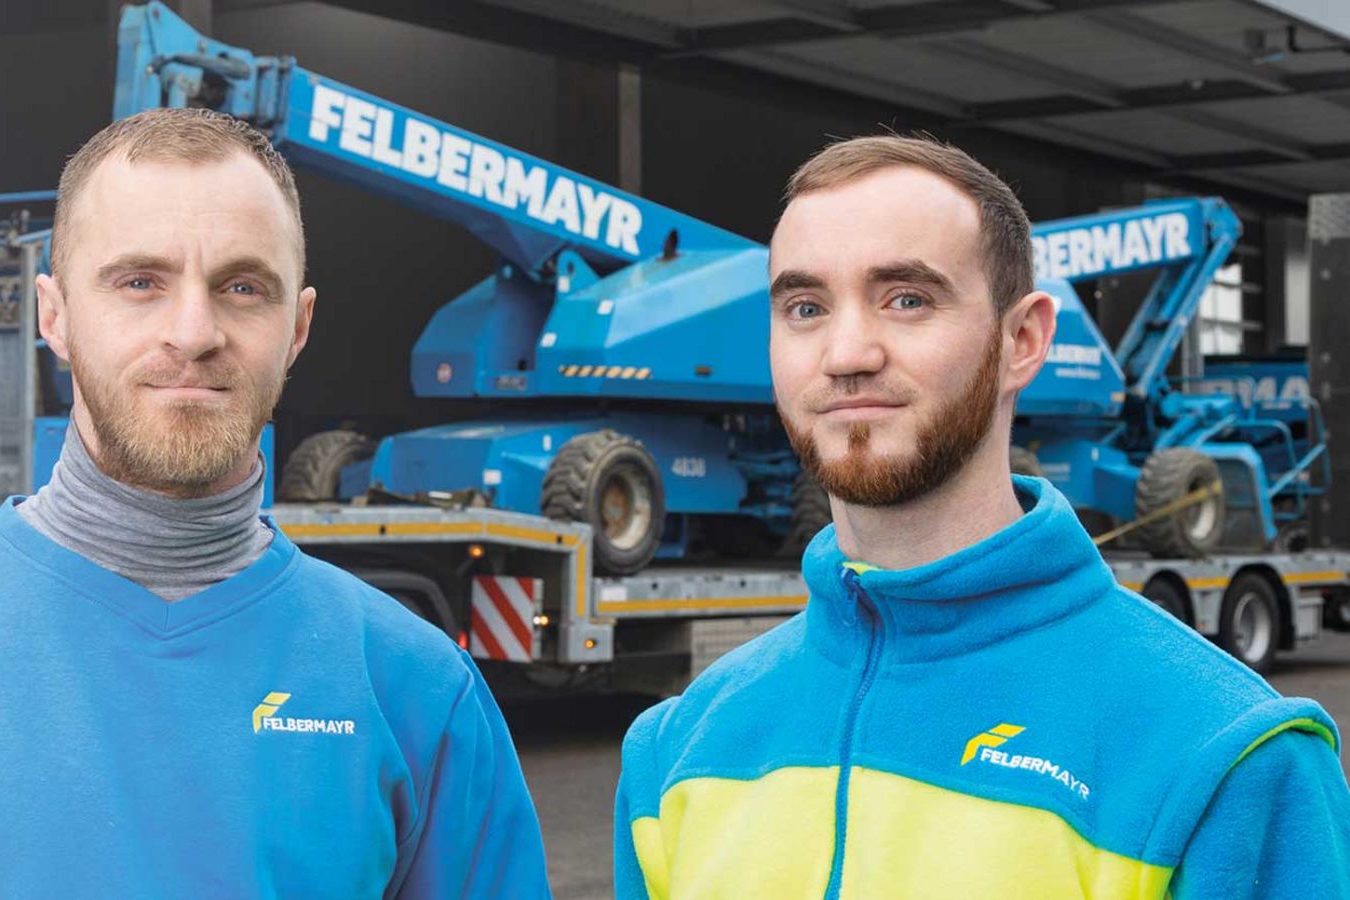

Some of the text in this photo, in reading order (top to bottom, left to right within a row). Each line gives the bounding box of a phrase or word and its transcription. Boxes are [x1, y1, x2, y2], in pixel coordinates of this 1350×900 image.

[308, 85, 642, 256] FELBERMAYR
[262, 717, 355, 734] FELBERMAYR
[980, 747, 1090, 801] FELBERMAYR
